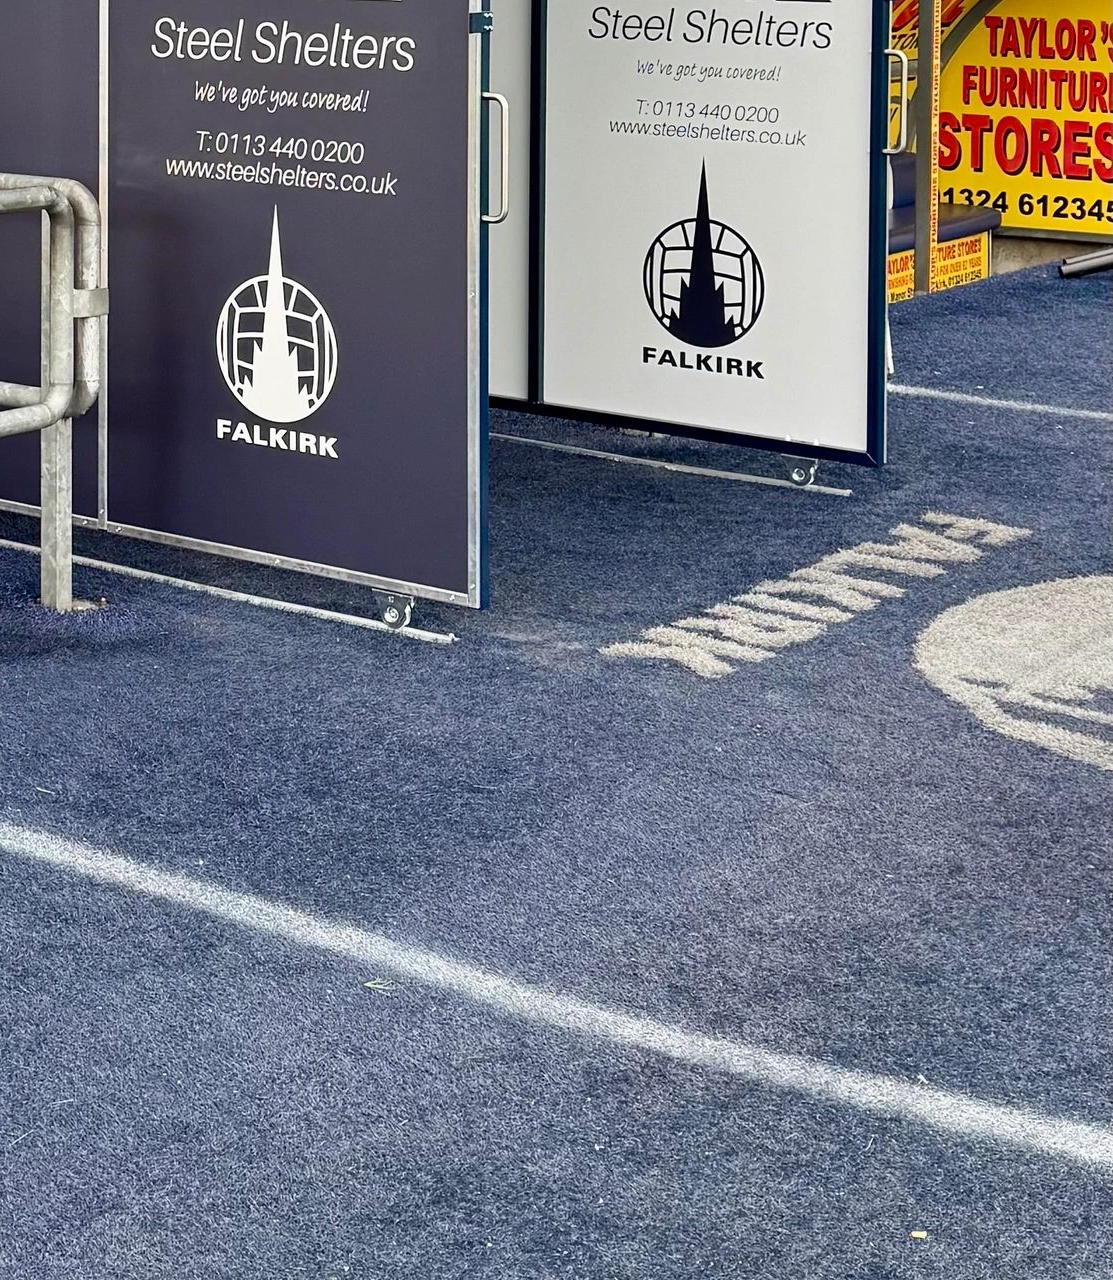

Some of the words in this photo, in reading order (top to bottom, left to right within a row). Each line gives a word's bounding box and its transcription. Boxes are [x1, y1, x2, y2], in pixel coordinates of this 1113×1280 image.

[150, 17, 245, 62] Steel
[251, 20, 417, 72] Shelters
[588, 6, 675, 42] Steel
[682, 9, 833, 49] Shelters
[636, 59, 673, 76] We've
[673, 63, 697, 81] got
[697, 66, 724, 83] you
[726, 66, 782, 82] covered!
[962, 65, 1113, 113] FURNITUR
[194, 80, 237, 108] We've
[236, 85, 268, 112] got
[267, 89, 299, 114] you
[301, 88, 370, 113] covered!
[698, 103, 732, 121] 440
[734, 105, 780, 124] 0200
[268, 136, 309, 161] 440
[310, 140, 365, 165] 0200
[609, 120, 807, 147] www.steelshelters.co.uk
[939, 112, 1113, 183] STORES
[165, 156, 399, 196] www.steelshelters.co.uk
[641, 346, 766, 381] FALKIRK
[216, 418, 339, 459] FALKIRK
